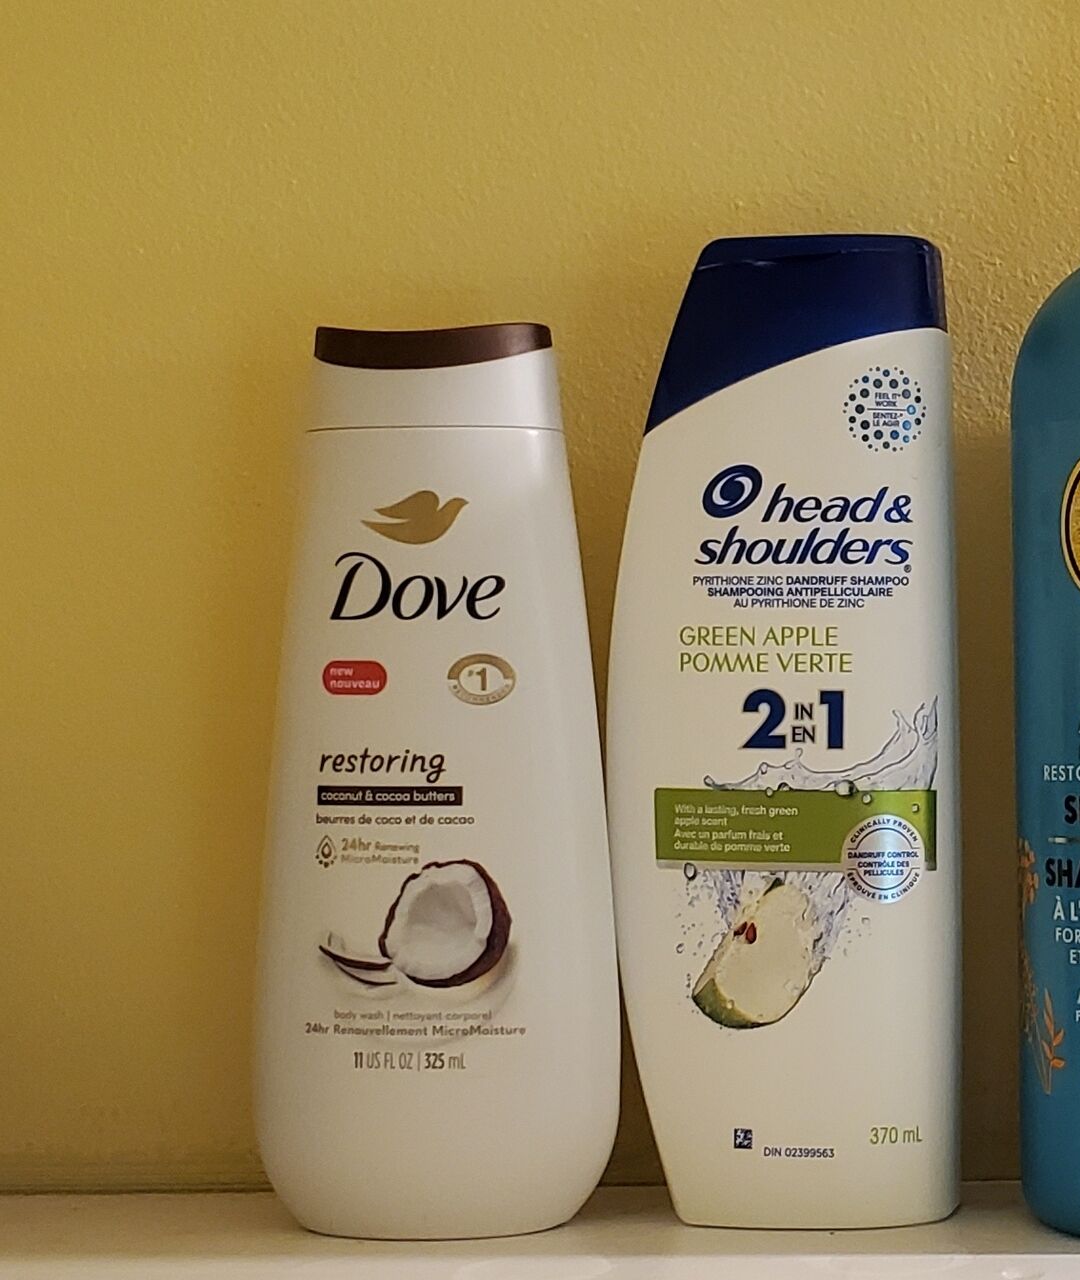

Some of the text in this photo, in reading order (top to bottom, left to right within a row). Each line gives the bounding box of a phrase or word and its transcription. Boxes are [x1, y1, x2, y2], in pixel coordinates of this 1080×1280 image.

[694, 525, 914, 565] shoulders
[329, 552, 506, 620] Dove
[692, 576, 910, 587] PYRITHIONE ZINC DANDRUFF SHAMPOO
[707, 587, 893, 598] SHAMPOOING ANTIPELLICULAIRE
[733, 598, 865, 608] AU PYRITHIONE DE ZINC
[679, 626, 839, 647] GREEN APPLE
[679, 652, 853, 673] POMME VERTE
[330, 667, 354, 677] new
[330, 680, 380, 689] nouveau
[740, 688, 787, 749] 2
[794, 703, 814, 720] IN
[820, 690, 845, 749] 1
[791, 726, 816, 744] EN
[319, 747, 447, 783] restoring
[321, 790, 456, 802] coconut & cocoa butters
[674, 804, 696, 814] With
[741, 805, 767, 816] fresh
[768, 807, 798, 818] green
[316, 813, 475, 825] beurres de coco et de cacao
[674, 829, 784, 840] Avec un parfum frais et
[850, 818, 918, 843] CLINICALLY PROVEN
[341, 837, 372, 851] 24hr
[674, 841, 790, 853] durable de pomme verte
[341, 854, 419, 865] MicroMoisture
[857, 860, 895, 868] CONTRÔLE
[891, 872, 920, 898] CLINIQUE
[1053, 895, 1066, 922] À
[334, 1010, 493, 1022] body wash nettoyant corporel
[305, 1022, 527, 1036] 24hr Renouvellement MicroMoisture
[354, 1052, 466, 1070] 11 US FL OZ 325 mL
[870, 1126, 923, 1144] 370 mL
[764, 1146, 835, 1158] DIN 02399563
